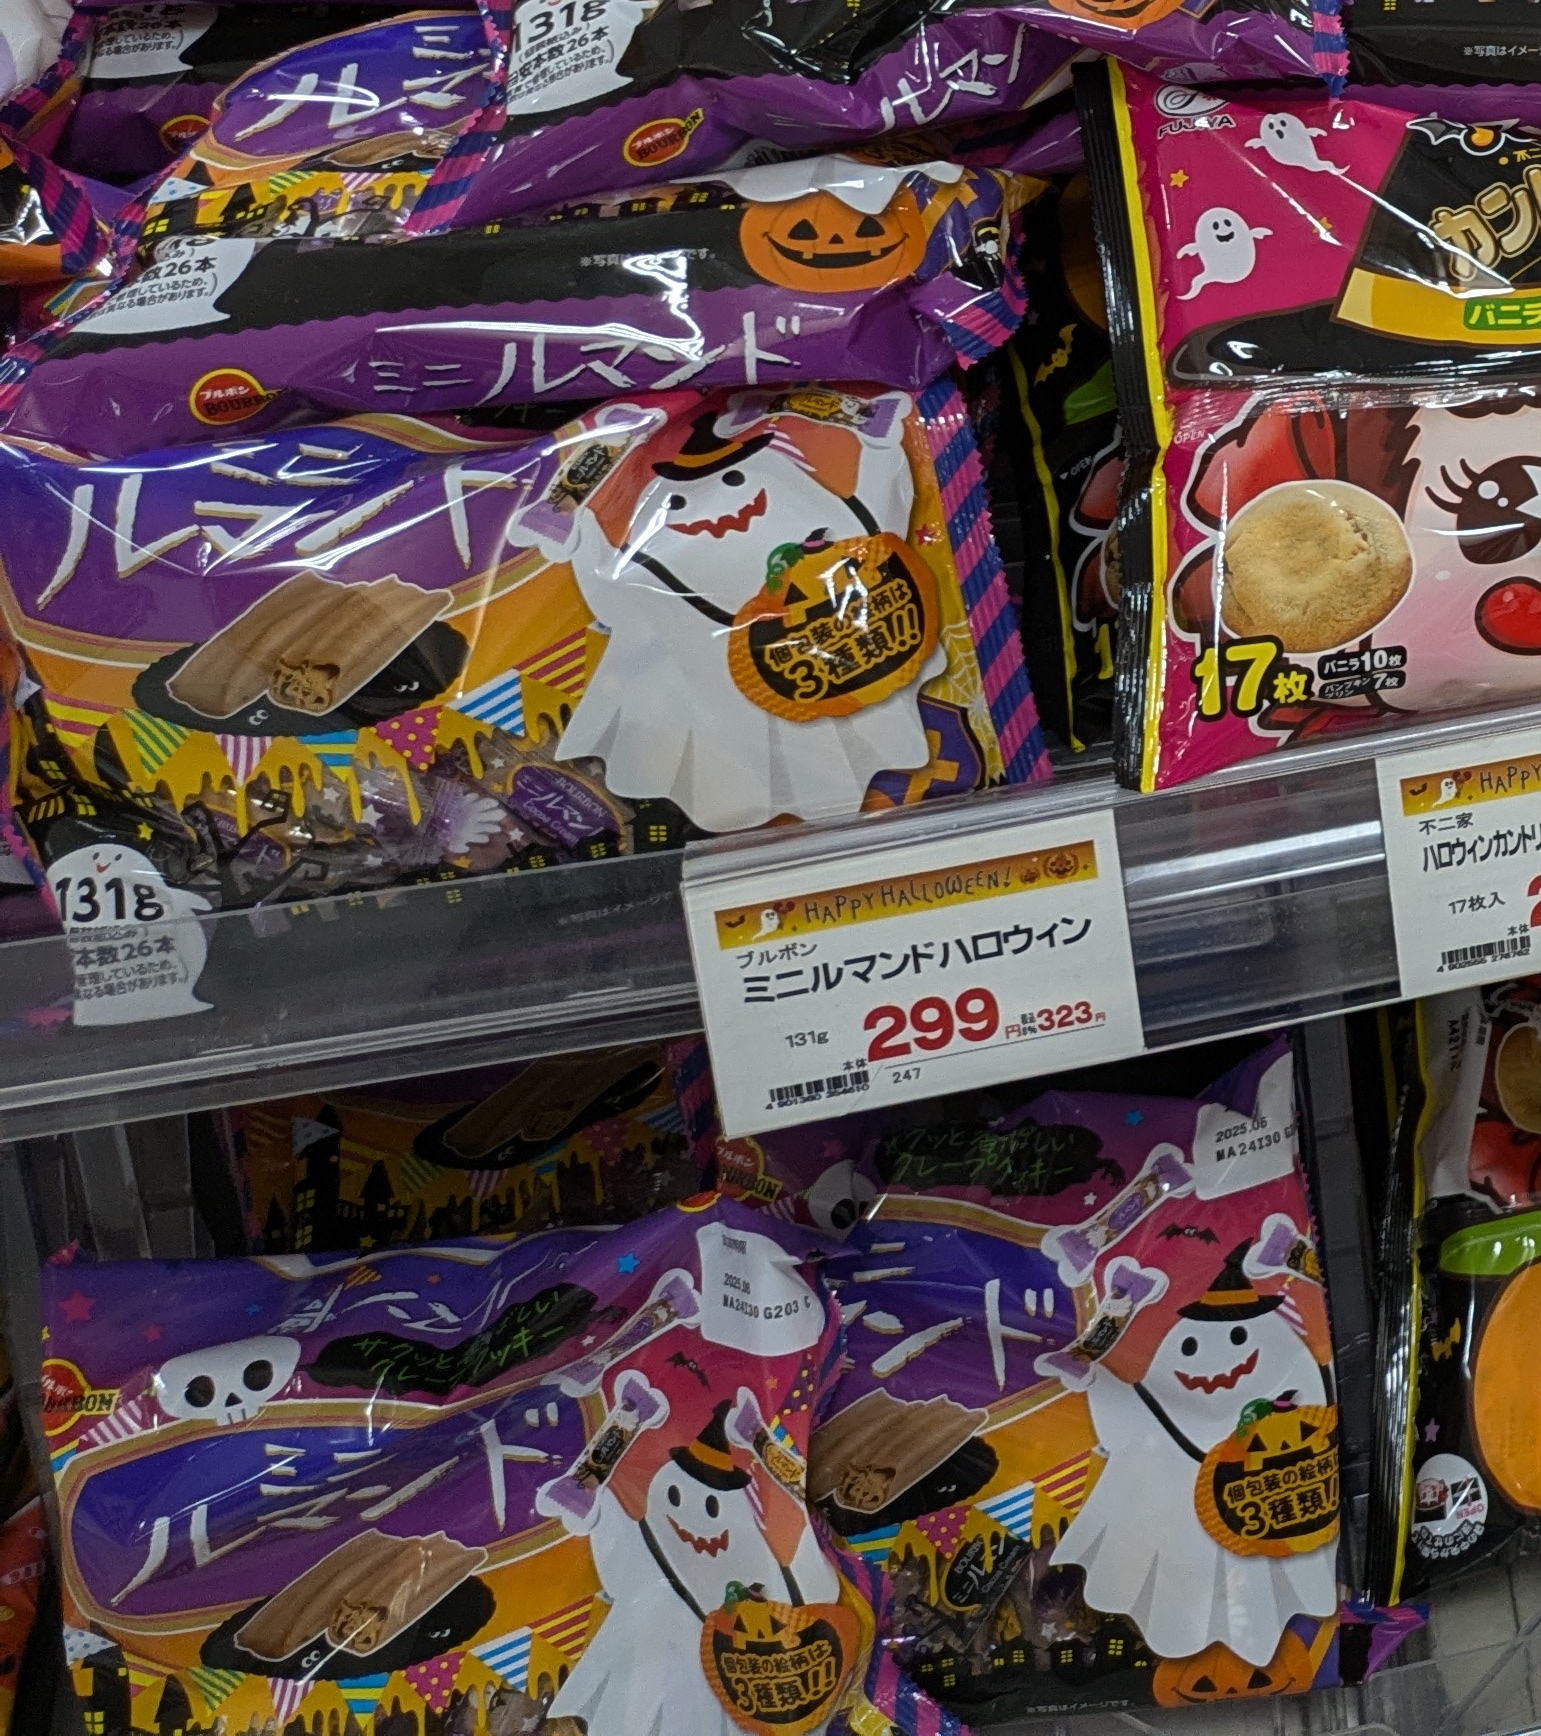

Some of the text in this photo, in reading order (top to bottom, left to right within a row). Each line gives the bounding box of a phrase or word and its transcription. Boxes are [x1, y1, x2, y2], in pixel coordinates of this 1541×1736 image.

[1419, 813, 1473, 835] 不二家
[54, 870, 165, 925] 131g
[1449, 892, 1505, 914] 17枚入
[736, 942, 817, 971] ブルボン
